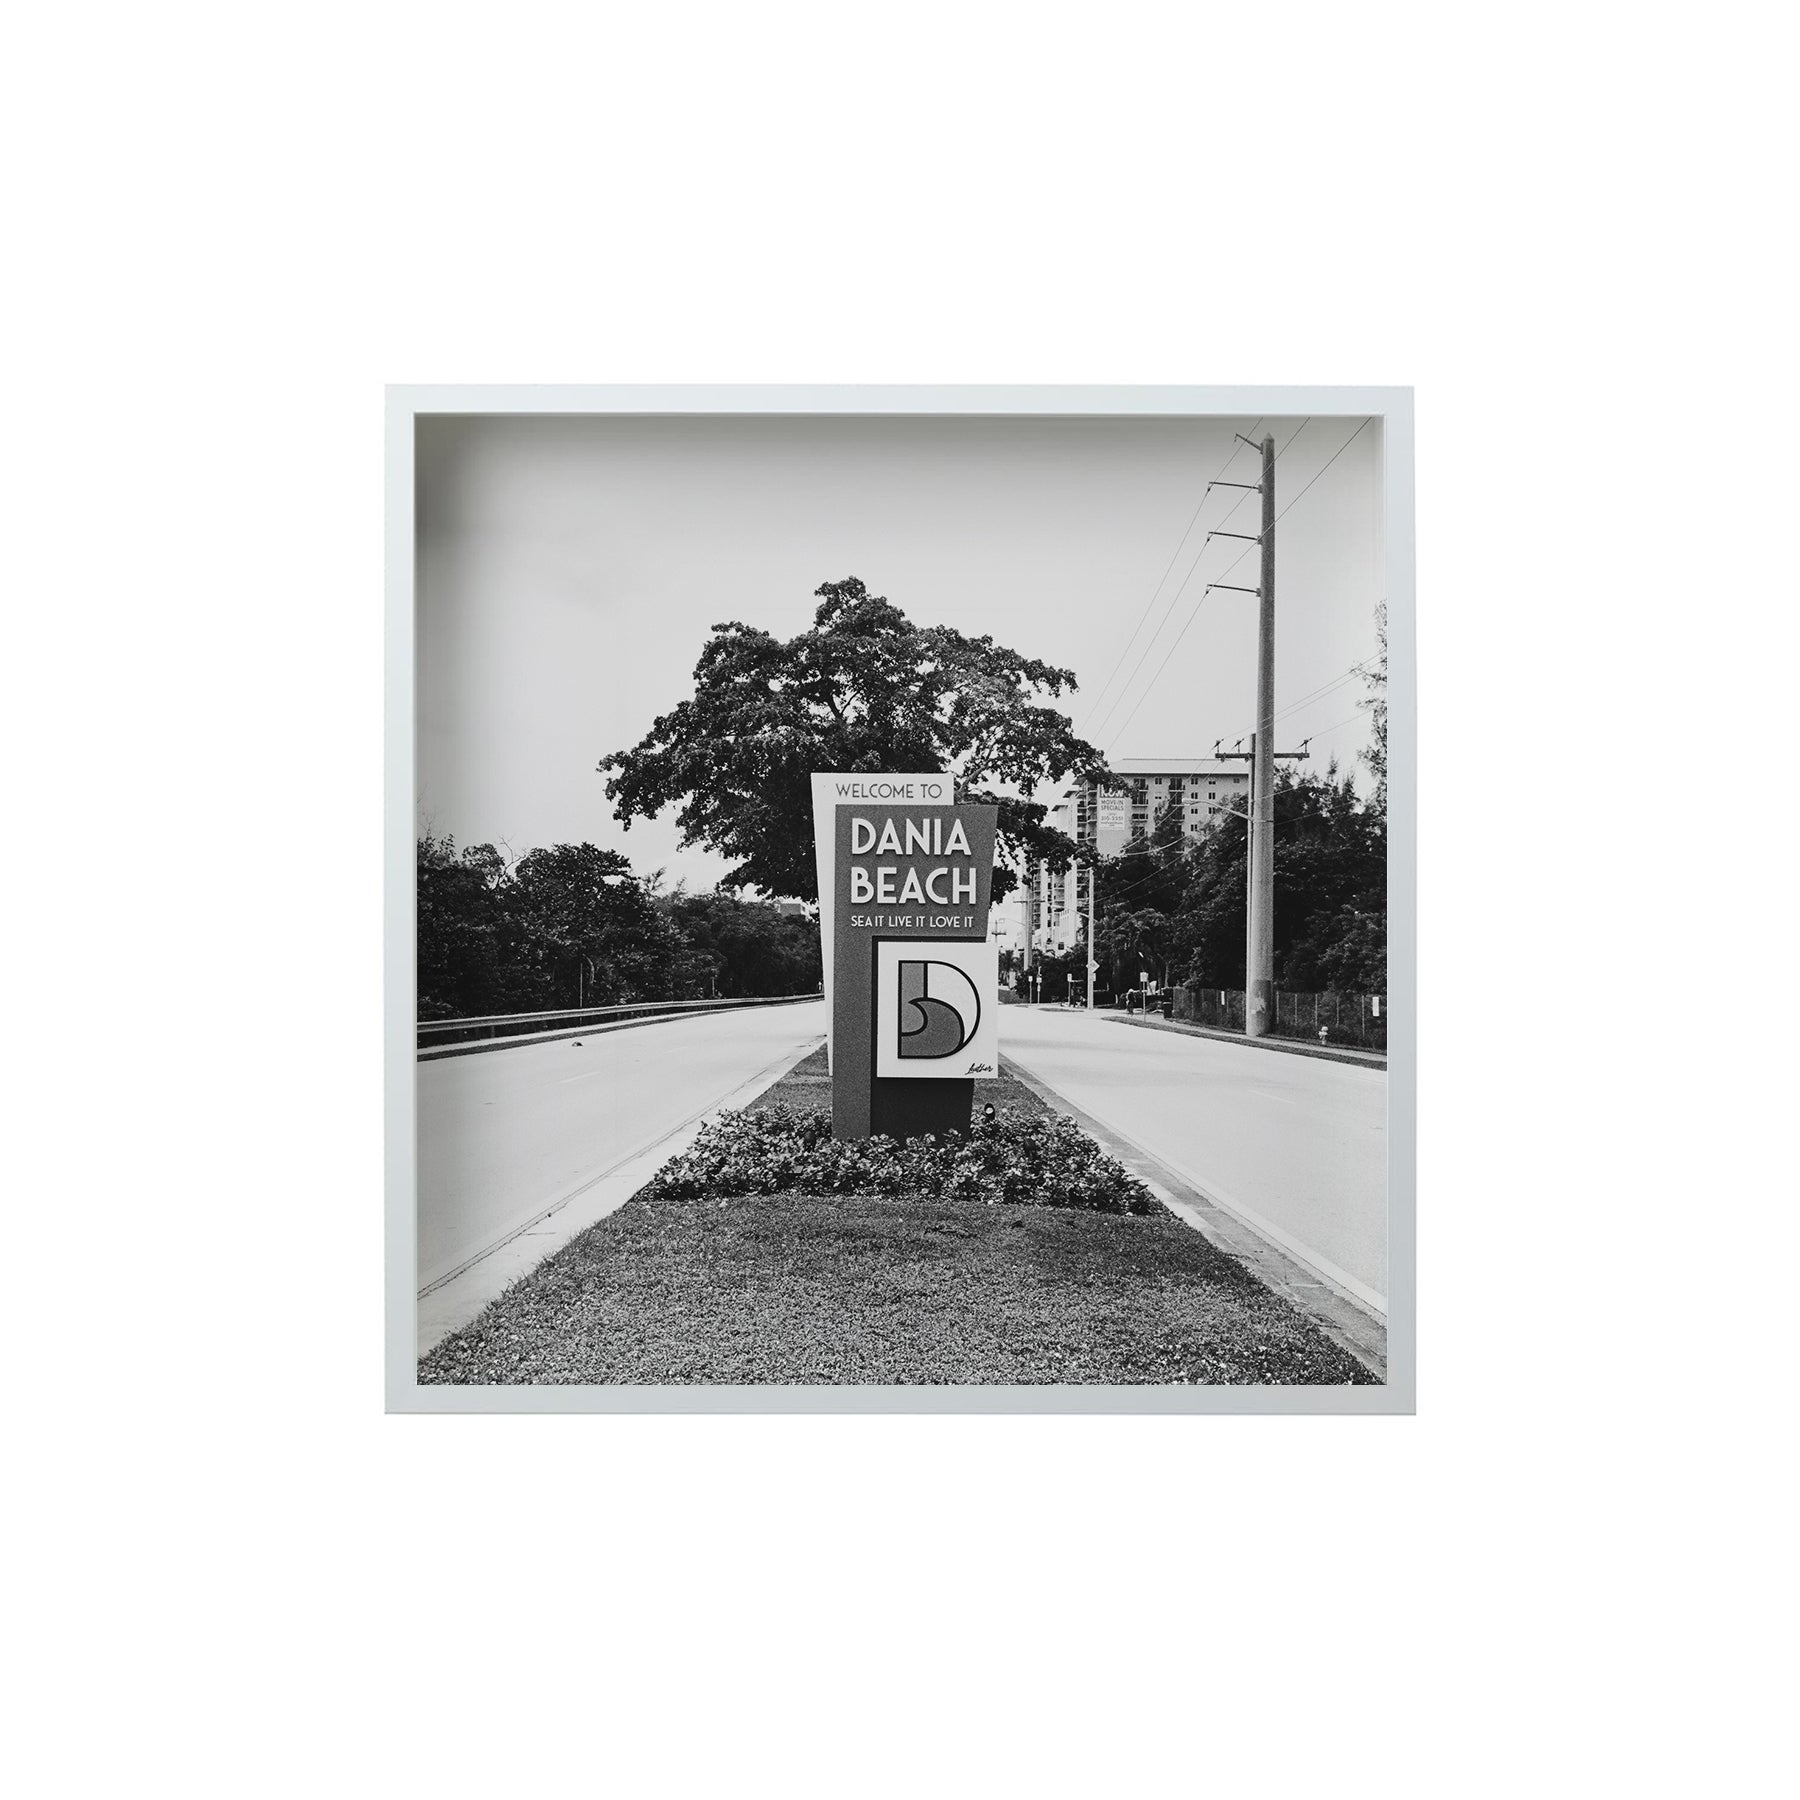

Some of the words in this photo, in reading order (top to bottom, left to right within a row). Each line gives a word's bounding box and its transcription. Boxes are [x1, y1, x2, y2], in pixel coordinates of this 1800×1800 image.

[836, 783, 914, 799] WELCOME
[921, 783, 943, 799] TO
[851, 818, 972, 856] DANIA
[851, 867, 977, 905] BEACH
[851, 915, 873, 927] SEA
[875, 915, 884, 927] IT
[888, 915, 912, 927] LIVE
[916, 916, 926, 927] IT
[930, 916, 960, 928] LOVE
[964, 916, 974, 928] IT
